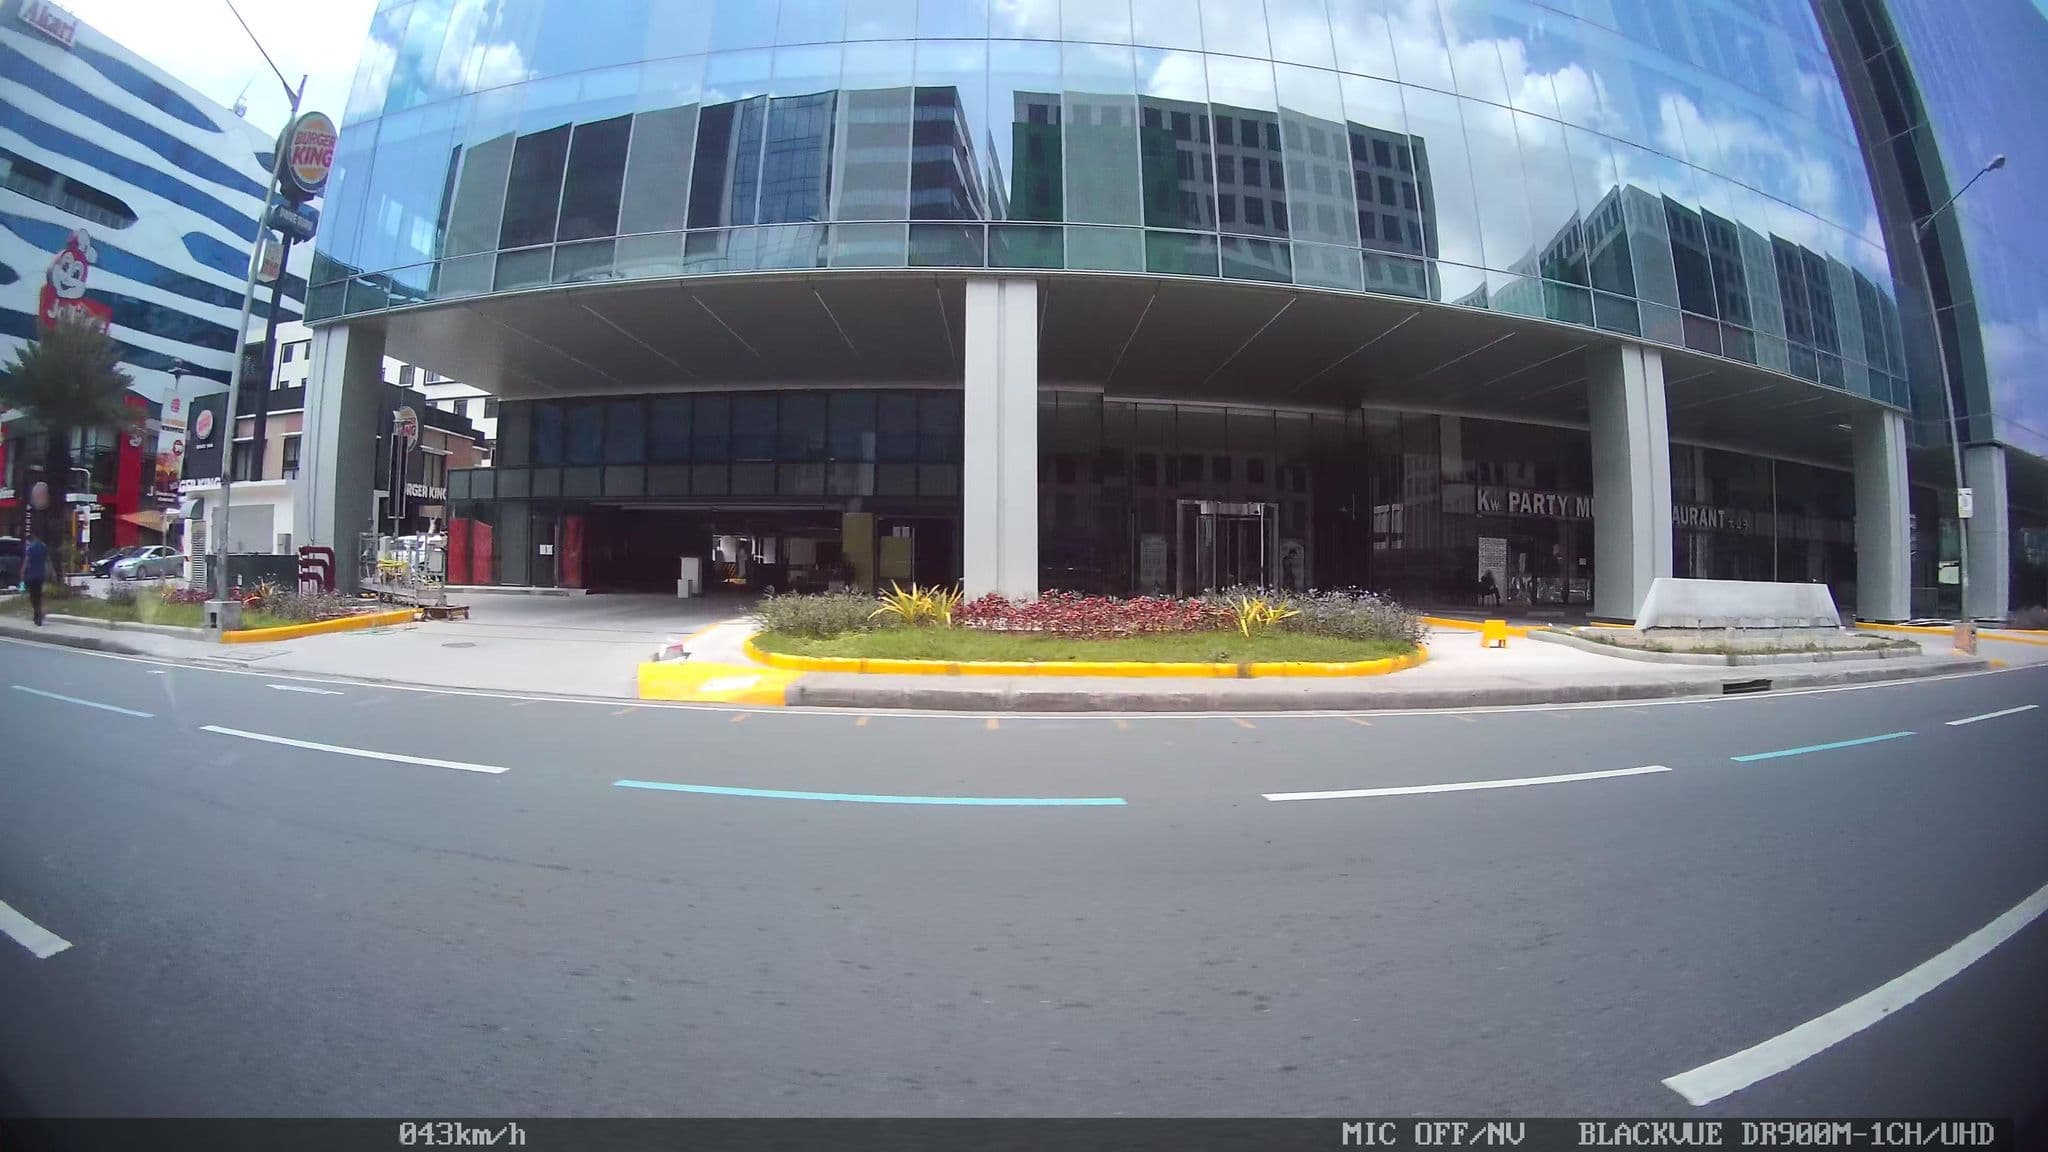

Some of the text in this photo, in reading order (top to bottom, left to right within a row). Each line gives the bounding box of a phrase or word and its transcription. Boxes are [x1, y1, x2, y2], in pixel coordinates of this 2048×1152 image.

[294, 131, 337, 149] BURGER
[291, 145, 334, 168] KING
[1508, 490, 1568, 517] PARTY
